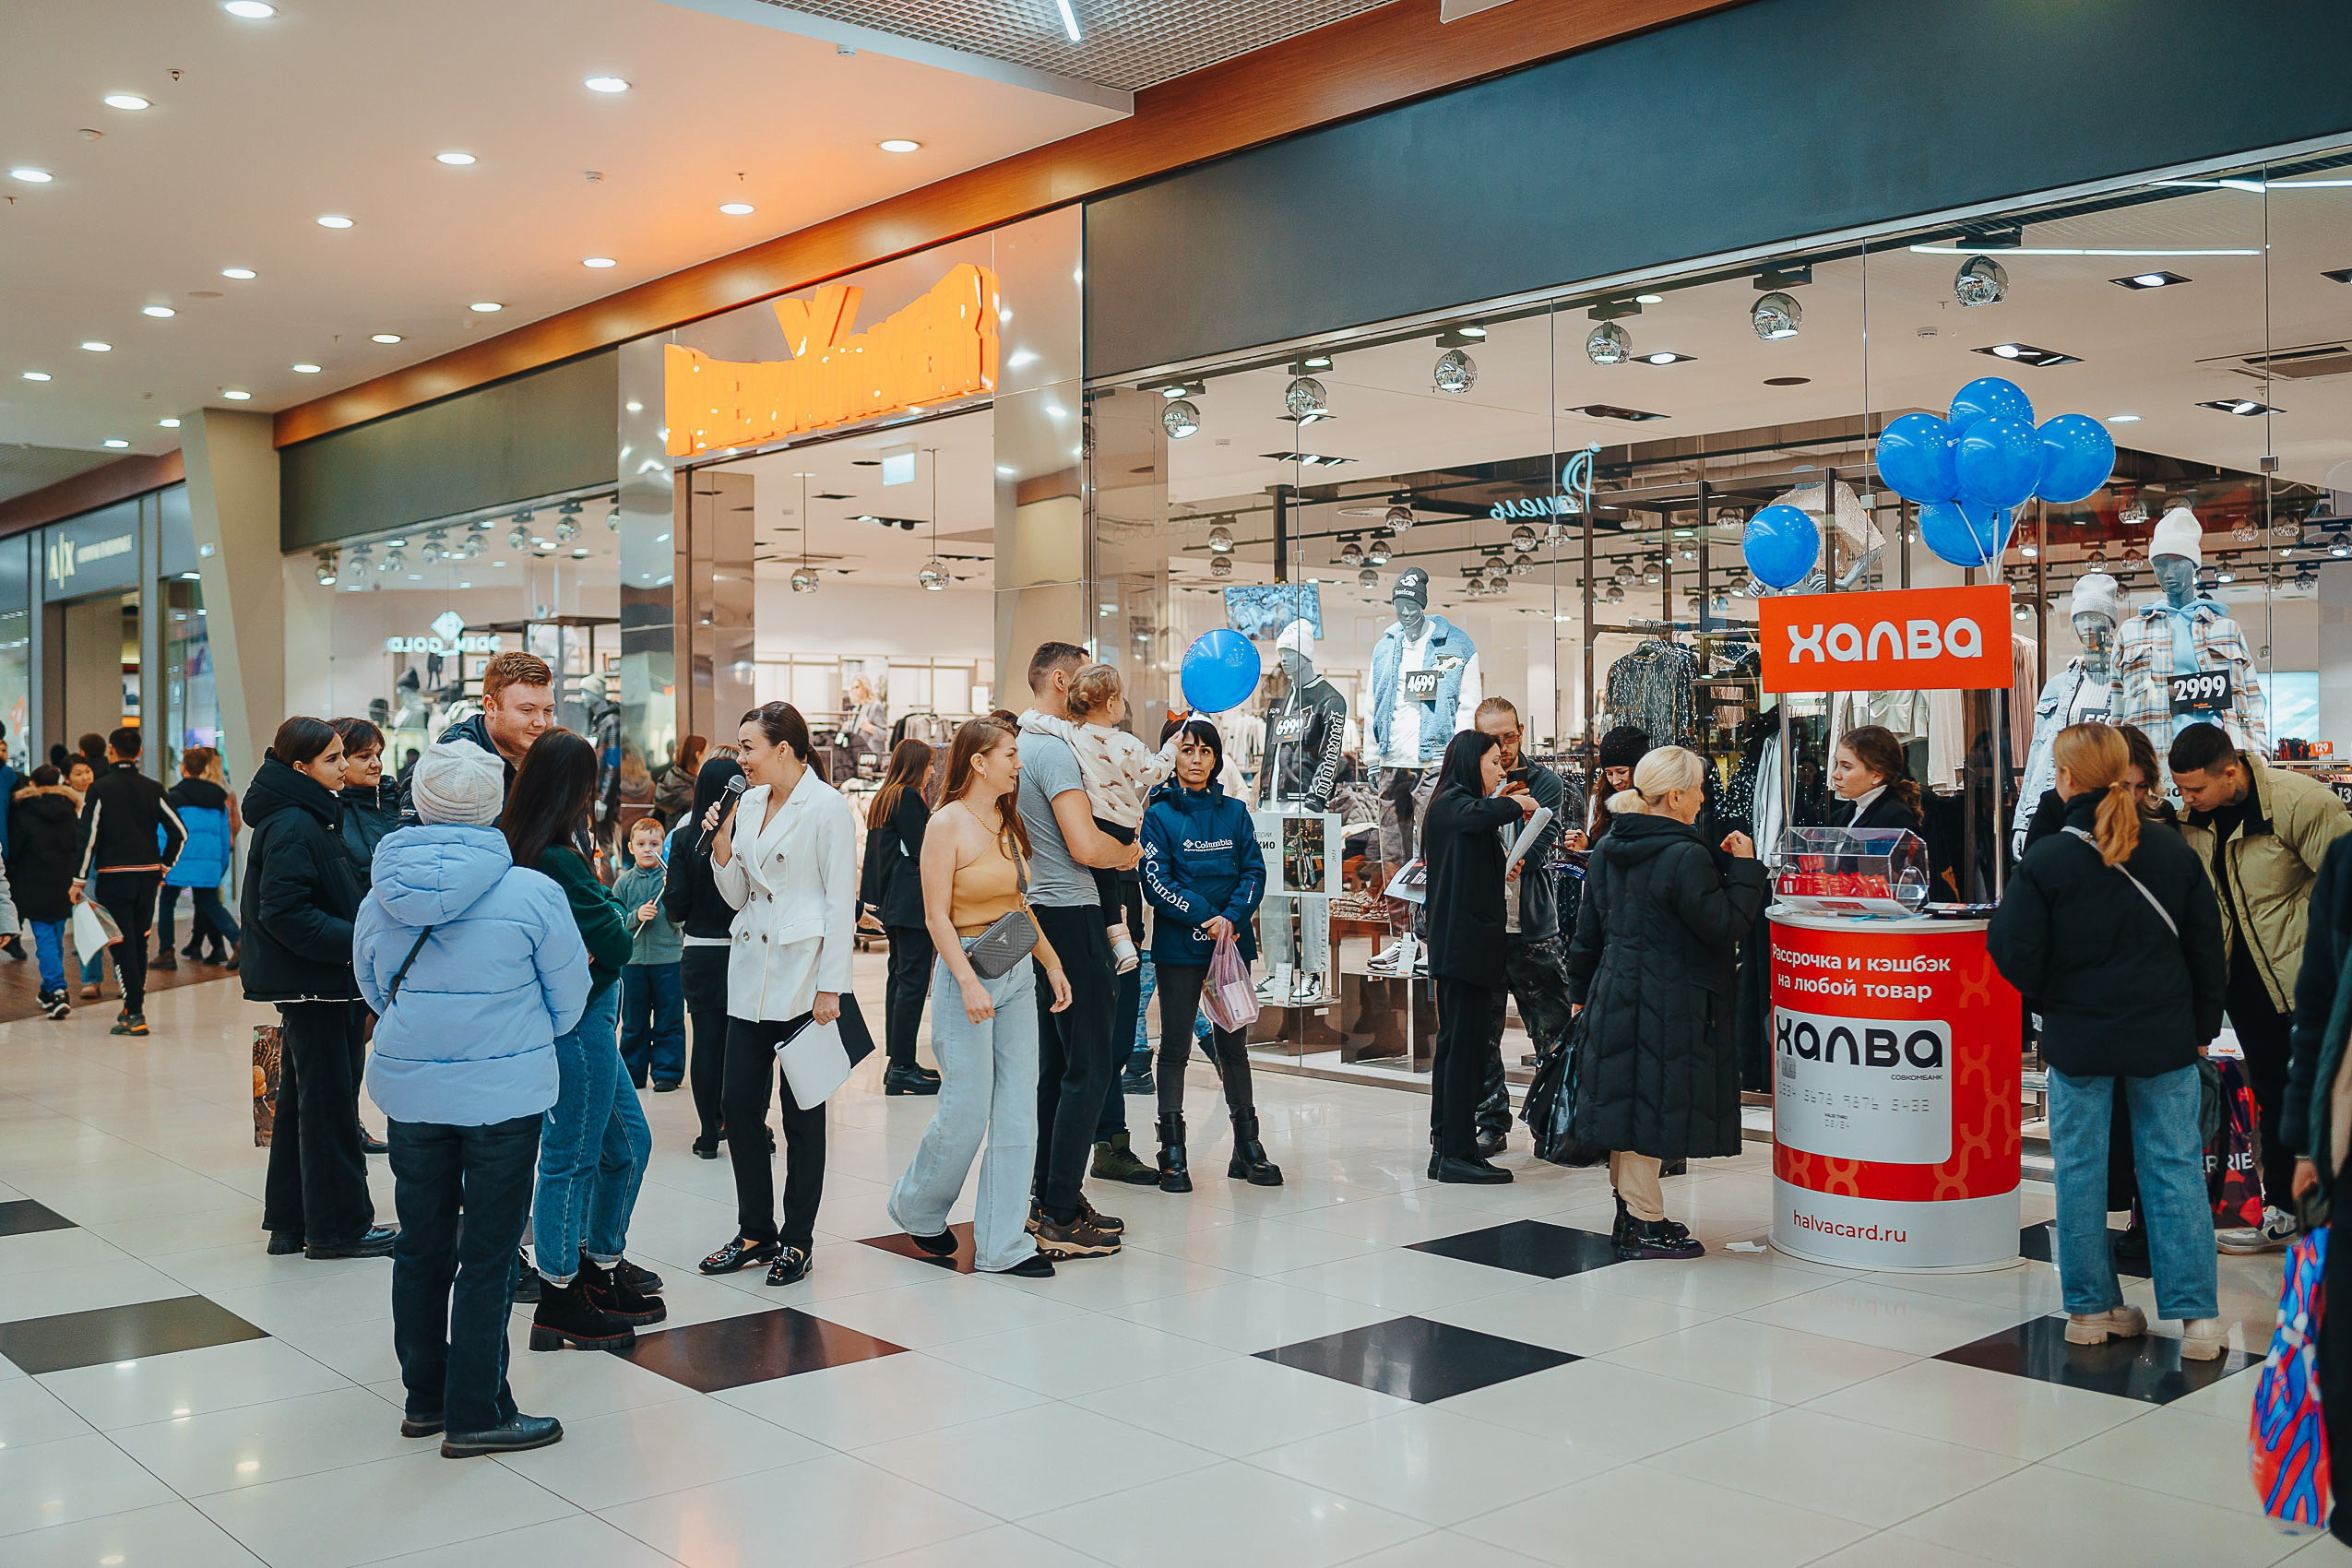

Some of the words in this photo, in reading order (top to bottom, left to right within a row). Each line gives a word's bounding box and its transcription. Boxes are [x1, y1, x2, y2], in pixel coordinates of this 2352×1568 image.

[1407, 674, 1436, 693] 4699
[2173, 674, 2227, 702] 2999
[1276, 717, 1304, 736] 6999
[2313, 742, 2329, 754] 129
[1194, 838, 1233, 849] Columbia
[1772, 943, 1842, 969] Рассрочка
[1847, 956, 1860, 971] и
[1867, 955, 1952, 972] кэшбэк
[1777, 973, 1791, 988] на
[1794, 977, 1857, 997] любой
[1863, 983, 1932, 1003] товар
[1793, 1209, 1907, 1242] halvacard.ru
